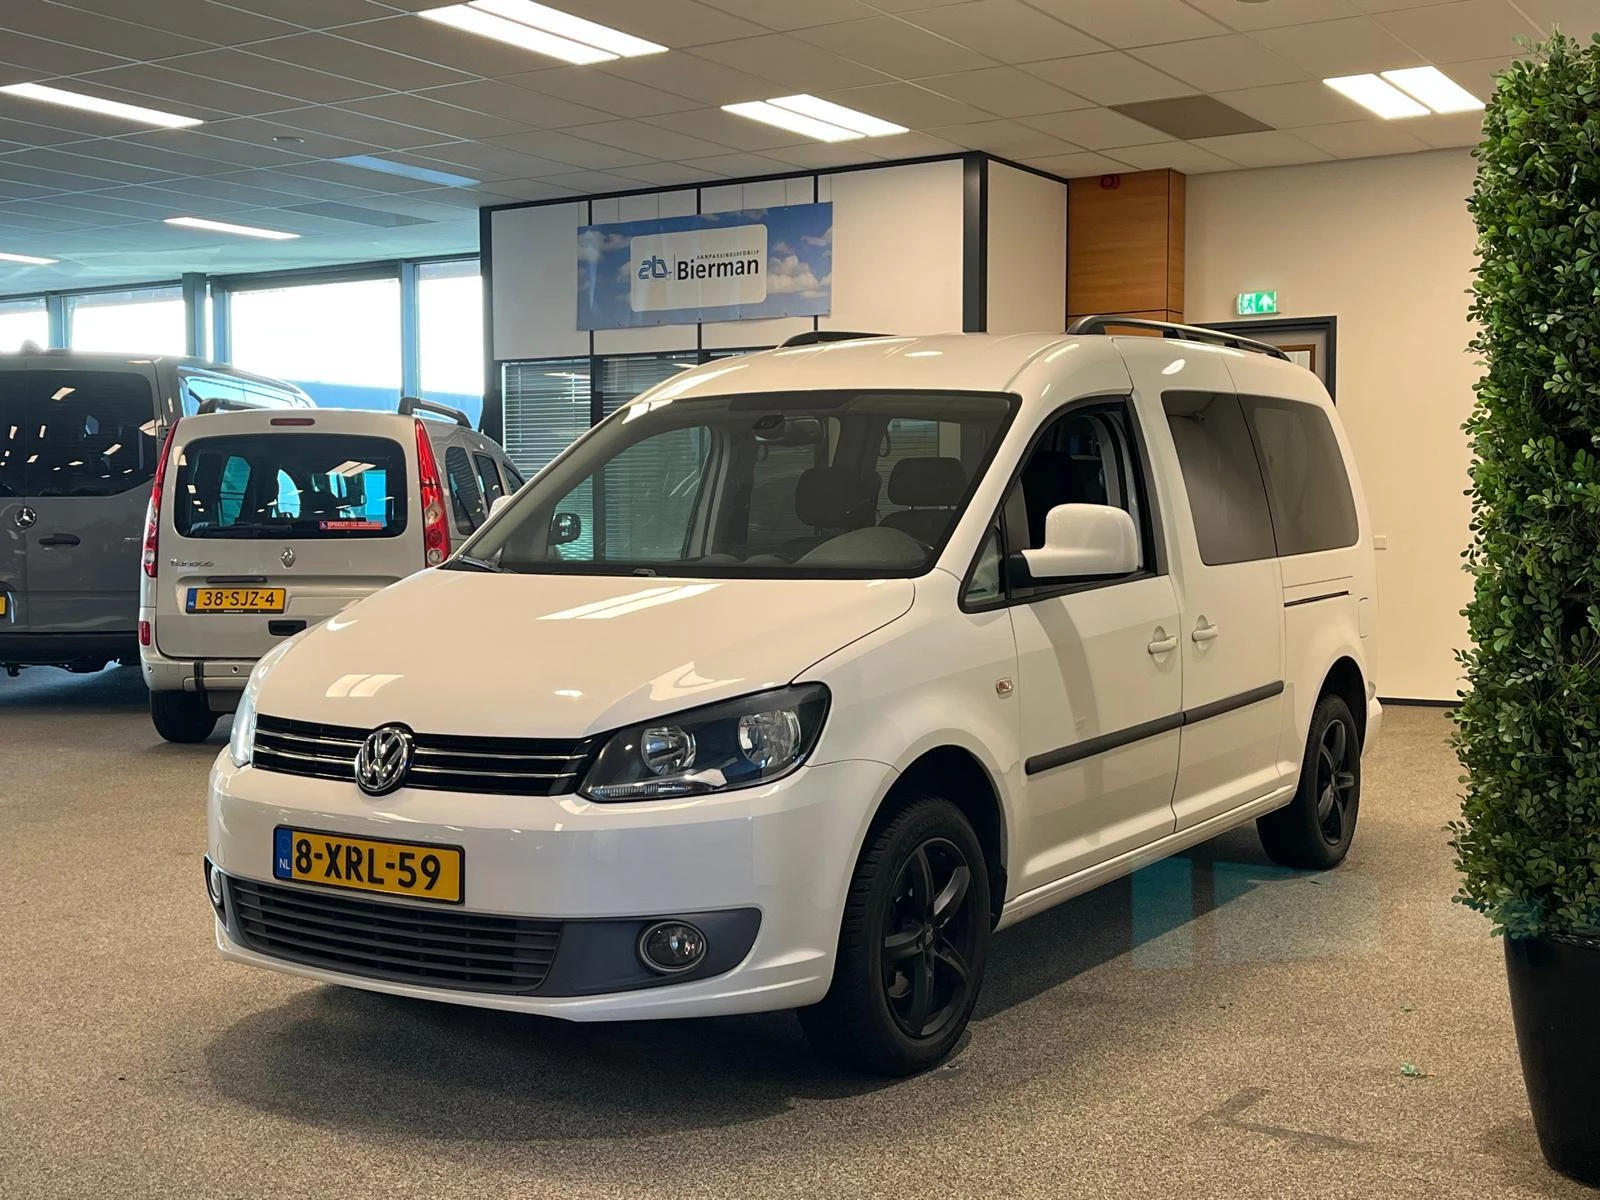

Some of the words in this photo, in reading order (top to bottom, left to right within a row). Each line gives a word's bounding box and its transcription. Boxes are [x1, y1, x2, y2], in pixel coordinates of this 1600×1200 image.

[677, 258, 759, 280] Bierman
[203, 591, 275, 606] 38-SJZ-4
[279, 858, 291, 870] NL
[295, 838, 441, 891] 8-XRL-59
